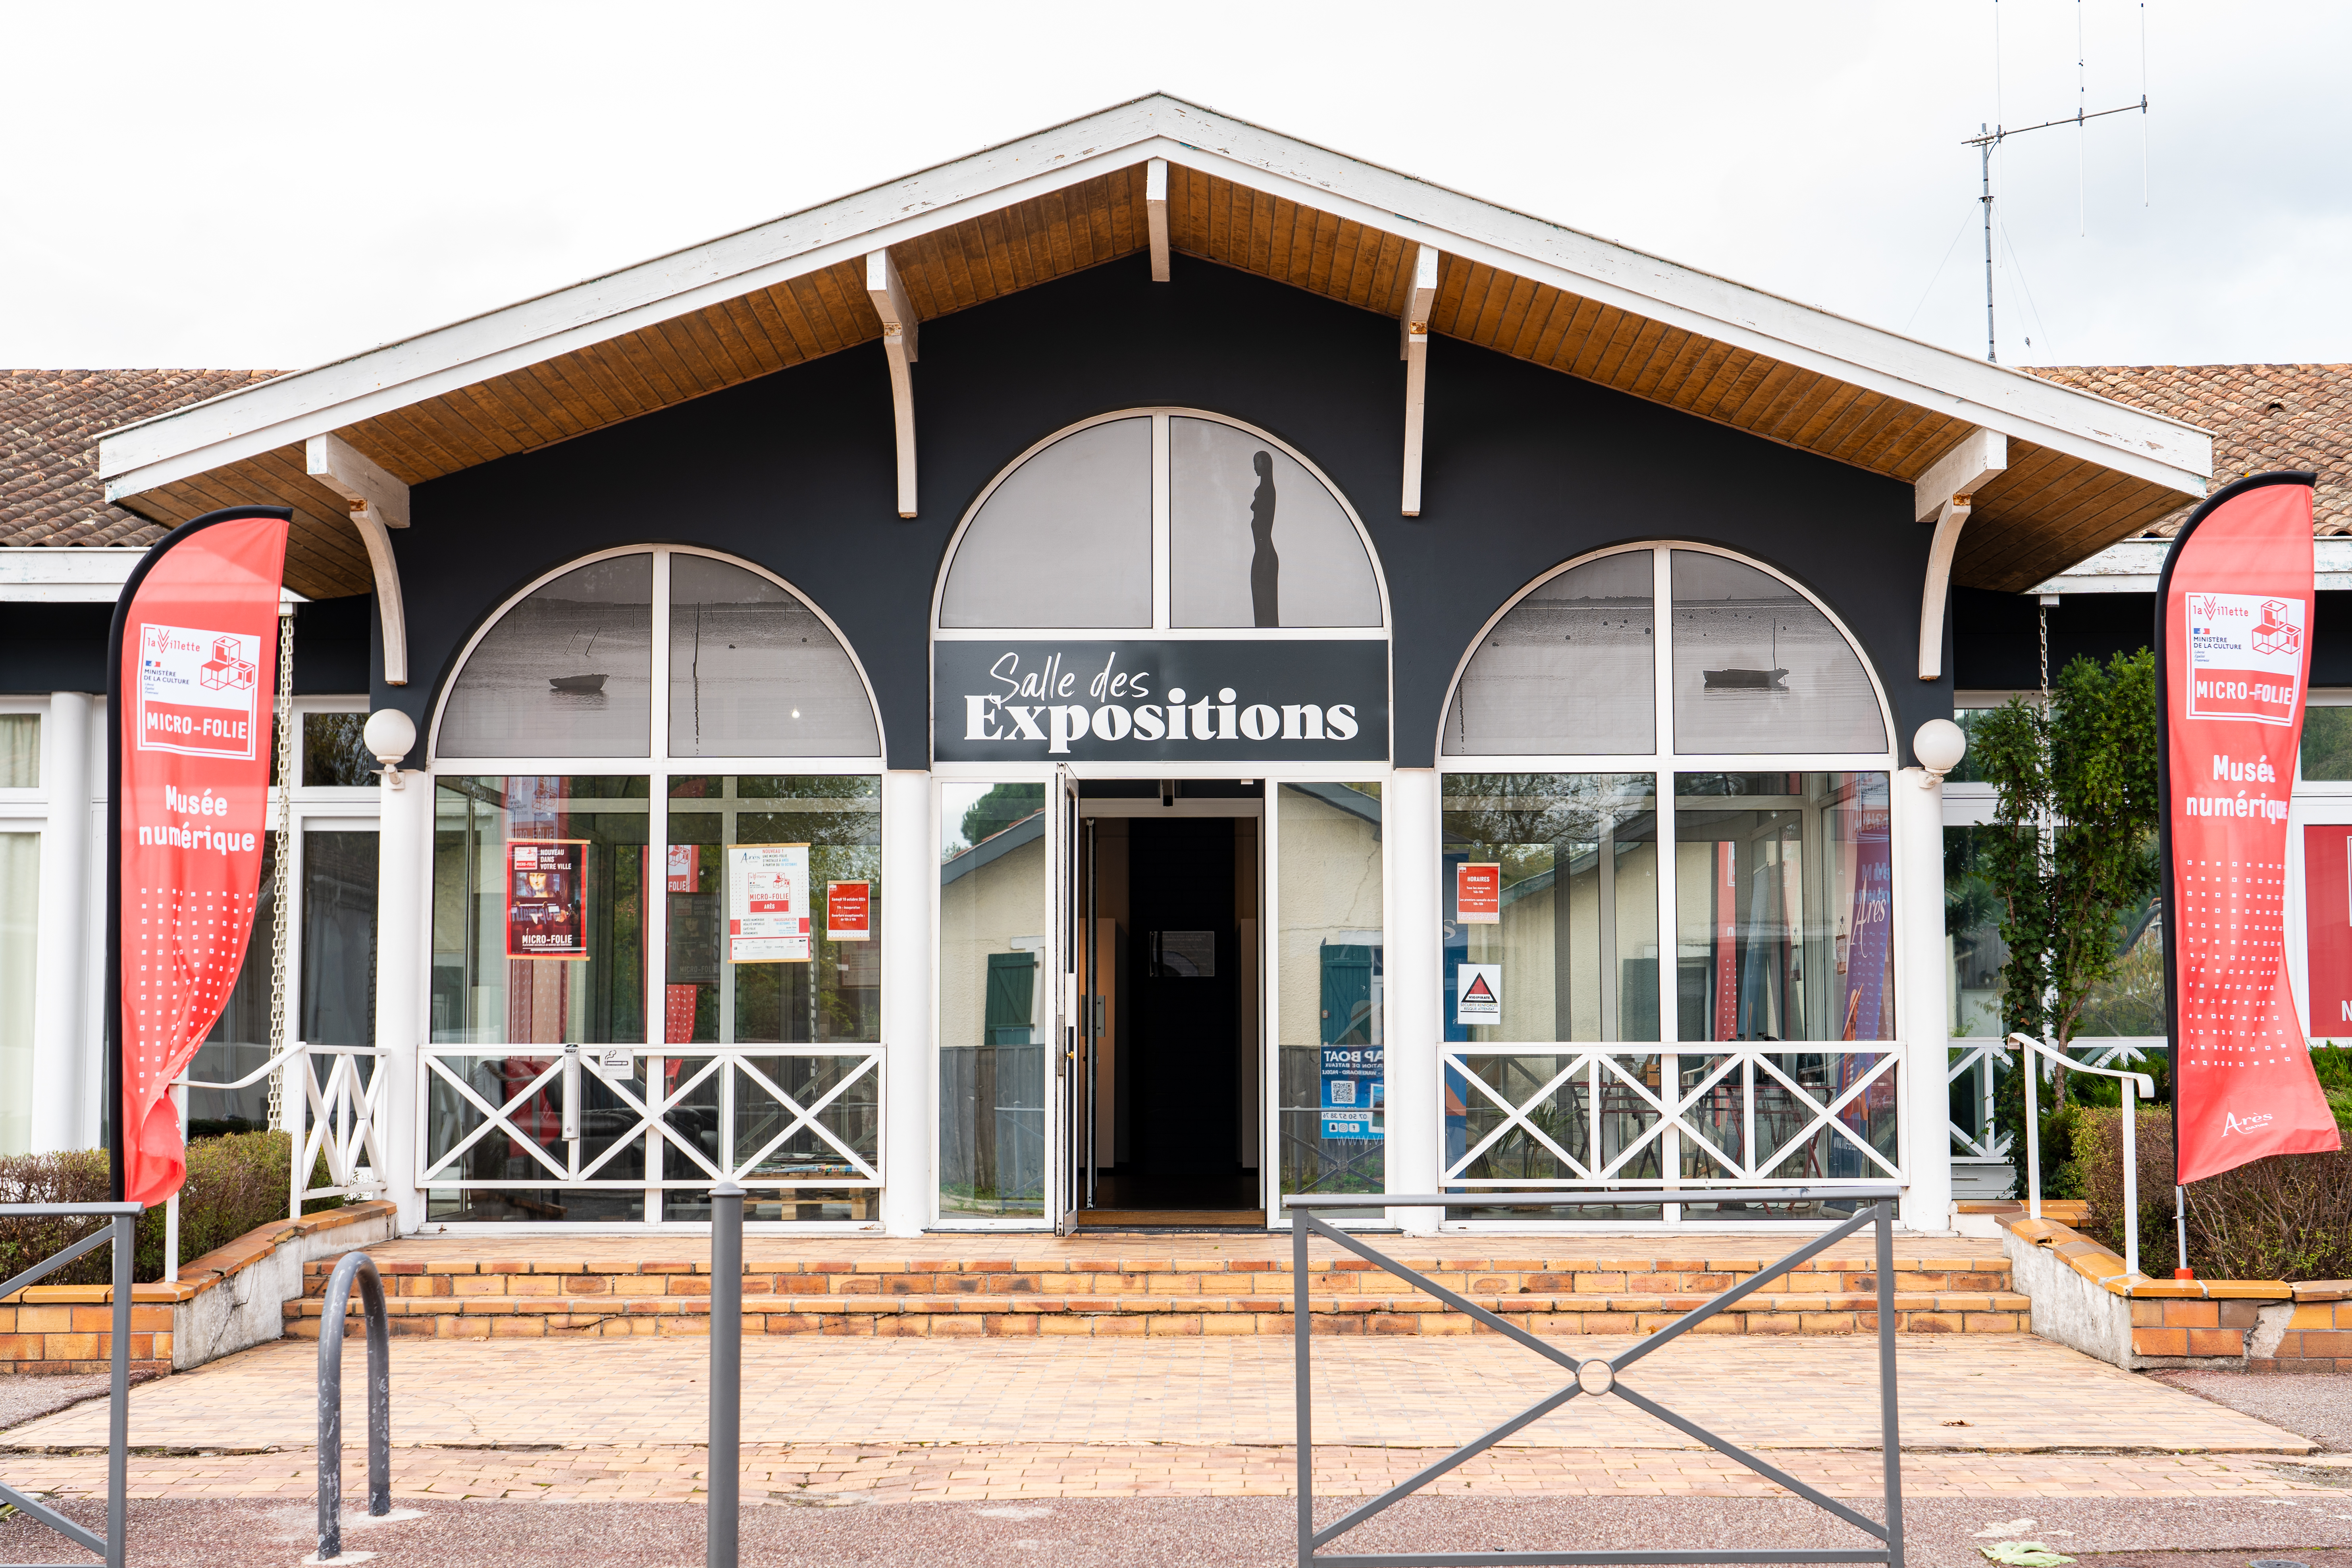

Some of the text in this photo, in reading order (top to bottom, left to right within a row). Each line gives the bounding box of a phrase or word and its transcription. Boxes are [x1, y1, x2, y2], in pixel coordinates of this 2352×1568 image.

[2193, 596, 2248, 620] la Villette
[148, 628, 200, 653] la Villette
[988, 651, 1149, 704] Salle des
[2196, 680, 2293, 705] MICRO-FOLIE
[147, 712, 247, 739] MICRO-FOLIE
[964, 687, 1358, 753] Expositions
[166, 784, 227, 816] Musée
[139, 821, 255, 855] numérique
[740, 852, 760, 865] Arès
[522, 934, 572, 944] MICRO-FOLIE
[2221, 1112, 2273, 1137] Arès
